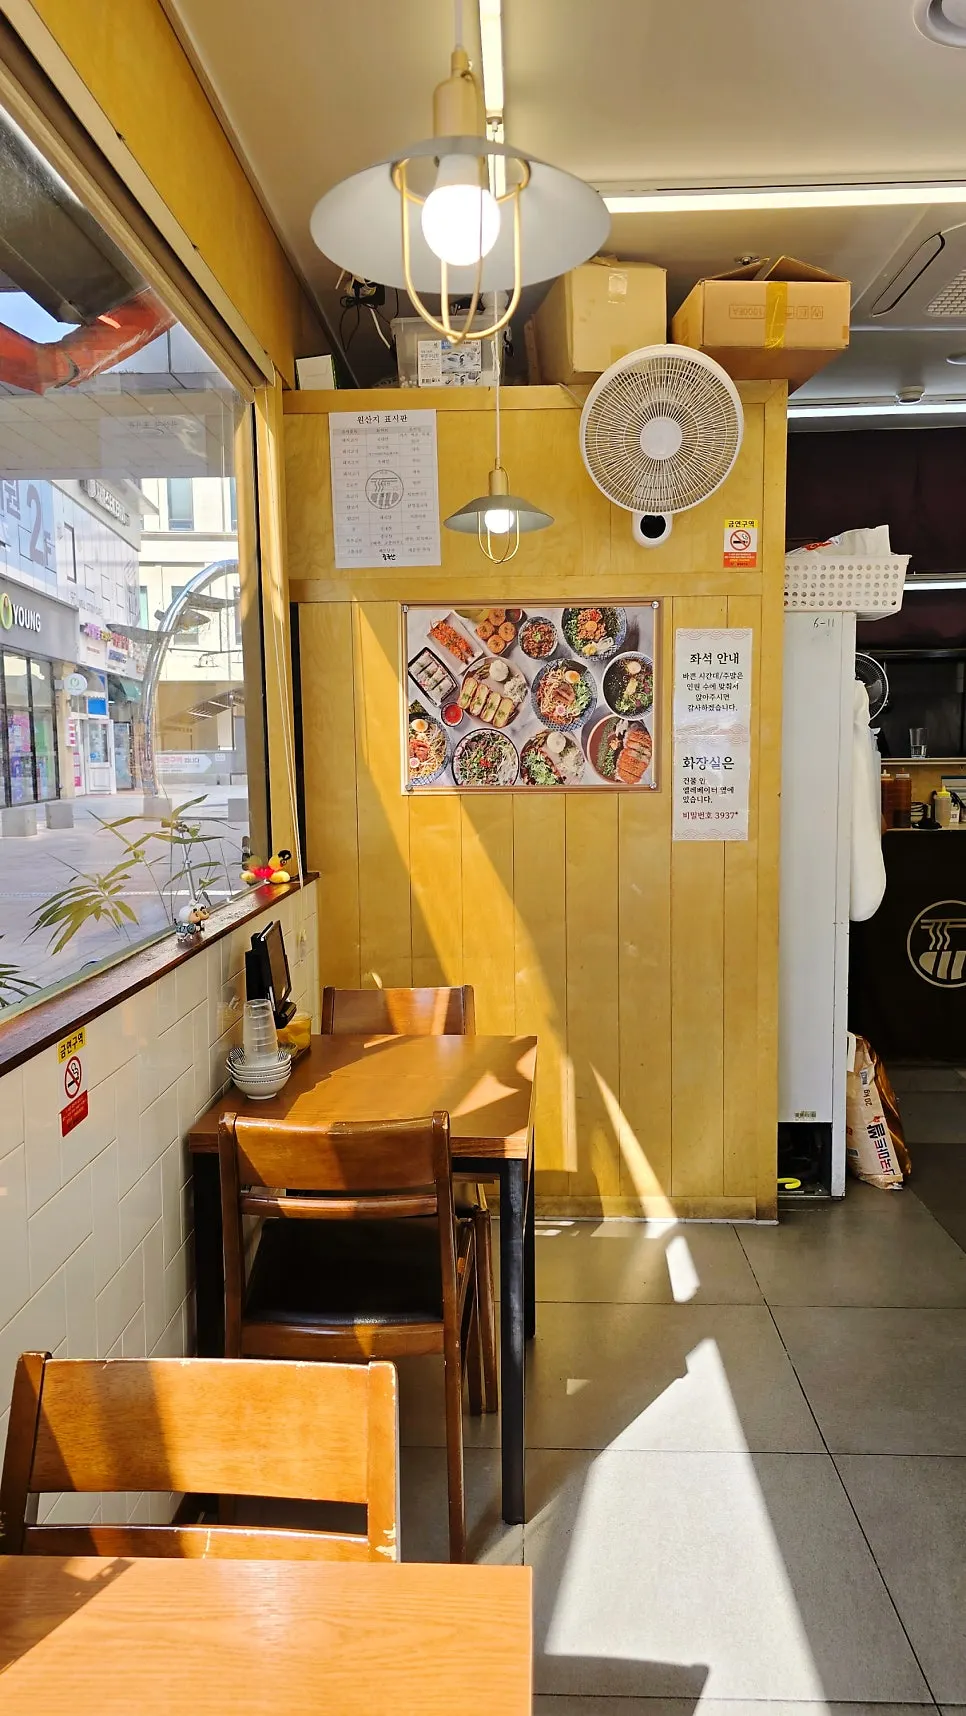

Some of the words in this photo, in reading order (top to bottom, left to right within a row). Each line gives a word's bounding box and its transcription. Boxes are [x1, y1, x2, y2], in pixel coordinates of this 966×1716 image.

[356, 415, 380, 425] 원산지
[384, 414, 408, 423] 표시판
[728, 520, 755, 528] 금연구역
[12, 604, 41, 633] YOUNG
[813, 617, 835, 628] 6-11
[690, 652, 712, 665] 좌석
[717, 652, 739, 664] 안내
[699, 672, 744, 680] 시간대/주말은
[686, 683, 700, 691] 인원
[703, 683, 716, 691] 수에
[718, 682, 739, 691] 맞춰서
[695, 693, 730, 701] 앉아주시면
[687, 704, 738, 712] 감사하겠습니다.
[682, 756, 735, 770] 화장실은
[683, 777, 697, 785] 건물
[699, 777, 706, 785] 안
[682, 786, 718, 794] 엘레베이터
[720, 786, 735, 795] 옆에
[682, 796, 713, 804] 있습니다.
[682, 812, 712, 820] 비밀번호
[59, 1032, 84, 1059] 금연구역
